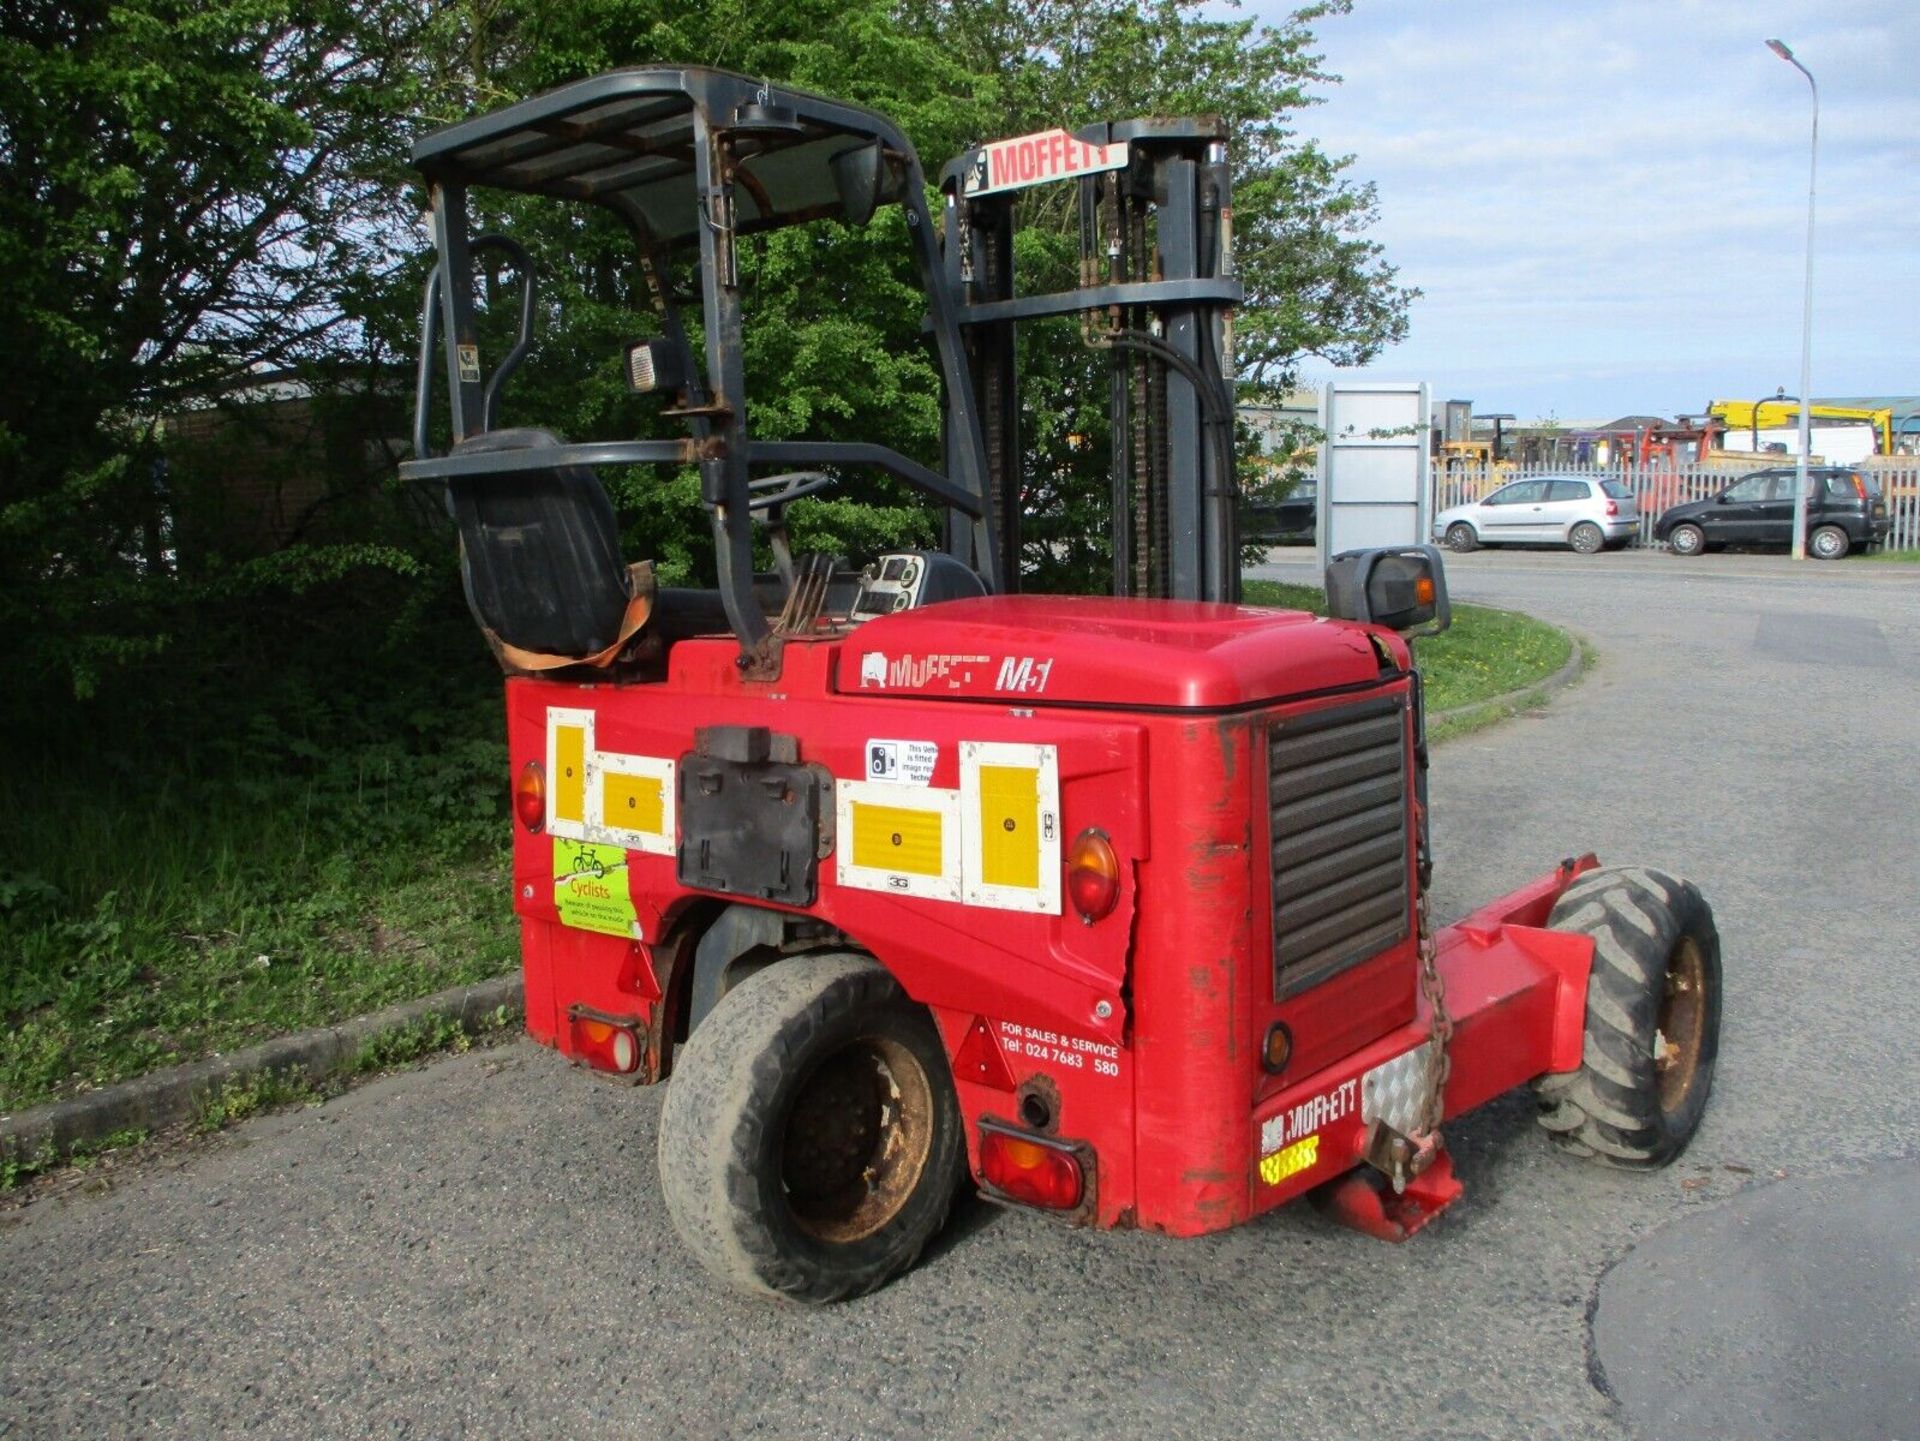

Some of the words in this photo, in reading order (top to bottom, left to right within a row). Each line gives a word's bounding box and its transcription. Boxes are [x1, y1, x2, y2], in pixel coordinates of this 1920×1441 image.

[570, 878, 611, 899] Cyclists
[1001, 1022, 1022, 1035] FOR
[1024, 1027, 1057, 1044] SALES
[1060, 1035, 1069, 1047] &
[1071, 1038, 1118, 1058] SERVICE
[1001, 1037, 1023, 1053] Tel:
[1025, 1043, 1048, 1059] 024
[1052, 1049, 1083, 1068] 7683
[1094, 1059, 1118, 1077] 580
